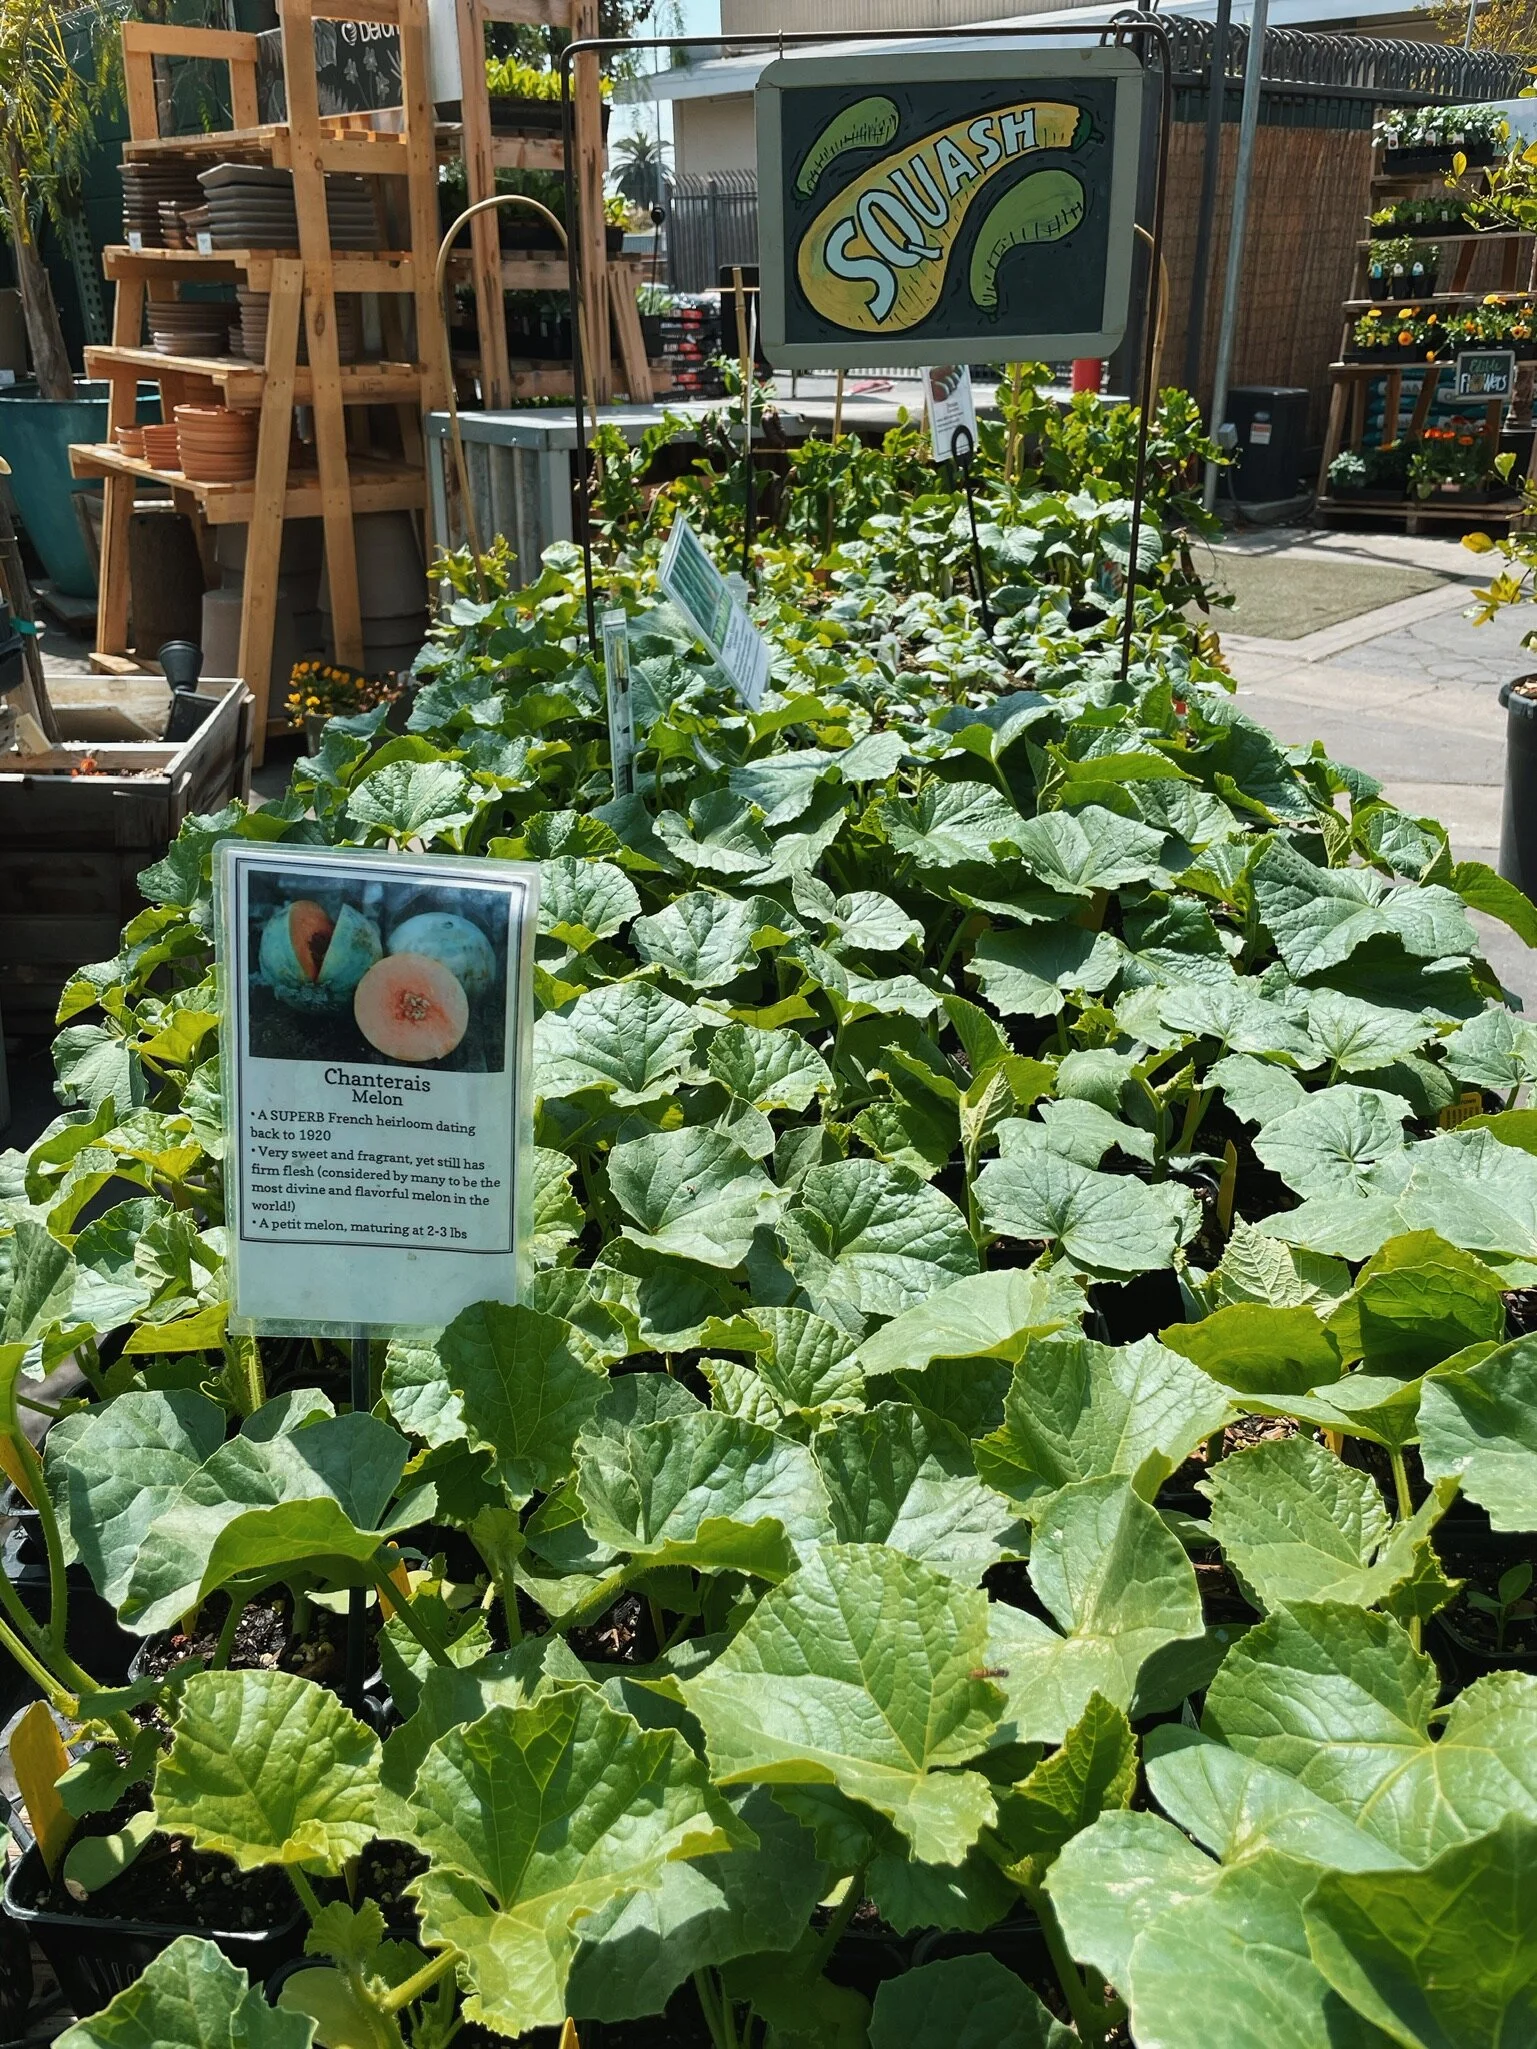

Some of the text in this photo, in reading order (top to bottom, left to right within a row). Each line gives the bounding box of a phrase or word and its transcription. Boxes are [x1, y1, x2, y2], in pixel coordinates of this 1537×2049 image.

[823, 108, 1038, 324] SQUASH
[324, 1068, 431, 1092] Chanterais
[352, 1089, 403, 1106] Melon
[250, 1126, 331, 1141] back to 1920
[257, 1109, 476, 1137] A SUPERB French heirloom dating
[258, 1146, 485, 1171] Very sweet and fragrant, yet still has
[251, 1163, 501, 1188] firm flesh (considered by many to be the
[251, 1183, 490, 1206] most divine and flavorful melon in the
[252, 1200, 296, 1213] world!)
[259, 1218, 468, 1240] A petit melon, maturing at 2-3 lbs
